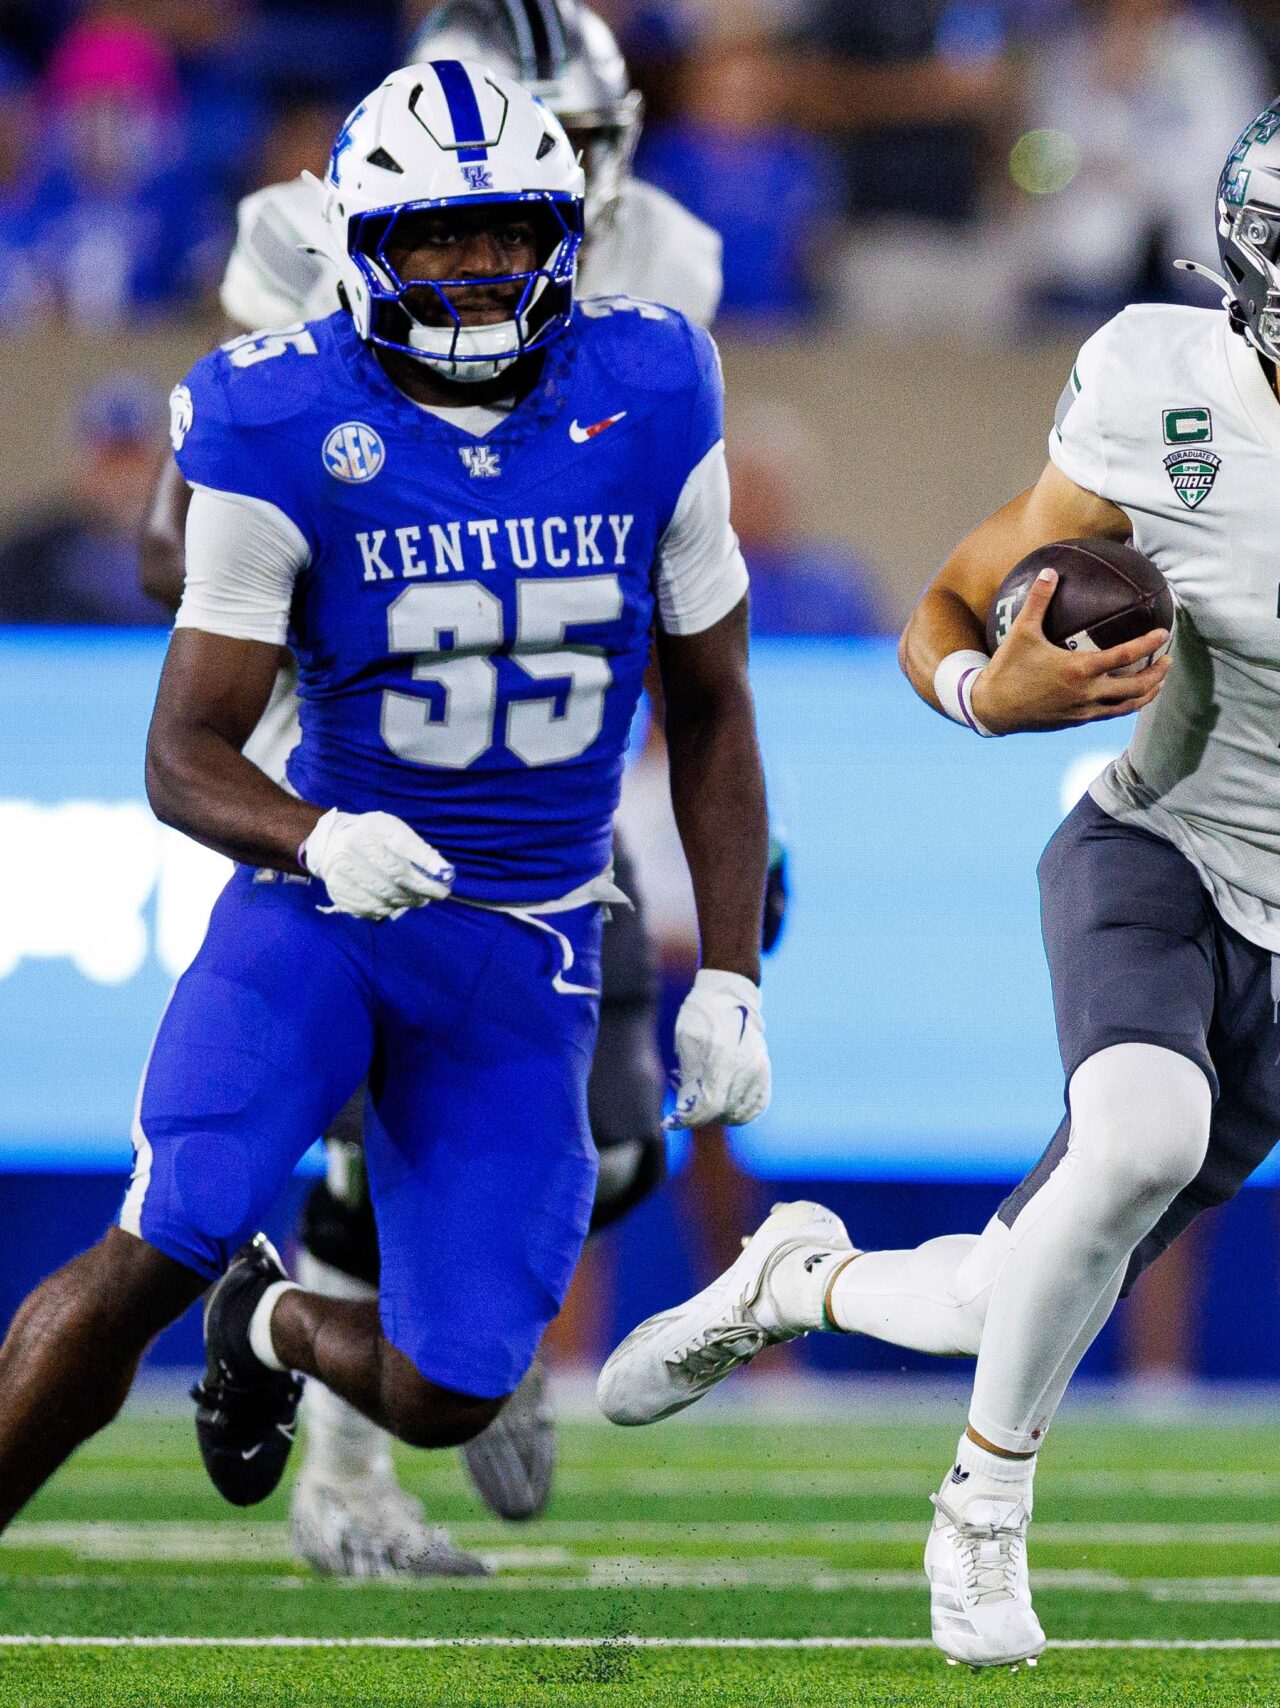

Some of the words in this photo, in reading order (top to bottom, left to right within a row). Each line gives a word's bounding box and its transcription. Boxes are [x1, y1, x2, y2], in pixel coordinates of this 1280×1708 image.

[461, 165, 494, 191] UK
[1165, 410, 1209, 442] C
[326, 426, 381, 480] SEC
[458, 445, 501, 479] UK
[1171, 452, 1211, 461] GRADUATE
[1172, 475, 1213, 488] MAC
[356, 515, 634, 581] KENTUCKY
[380, 575, 624, 769] 35
